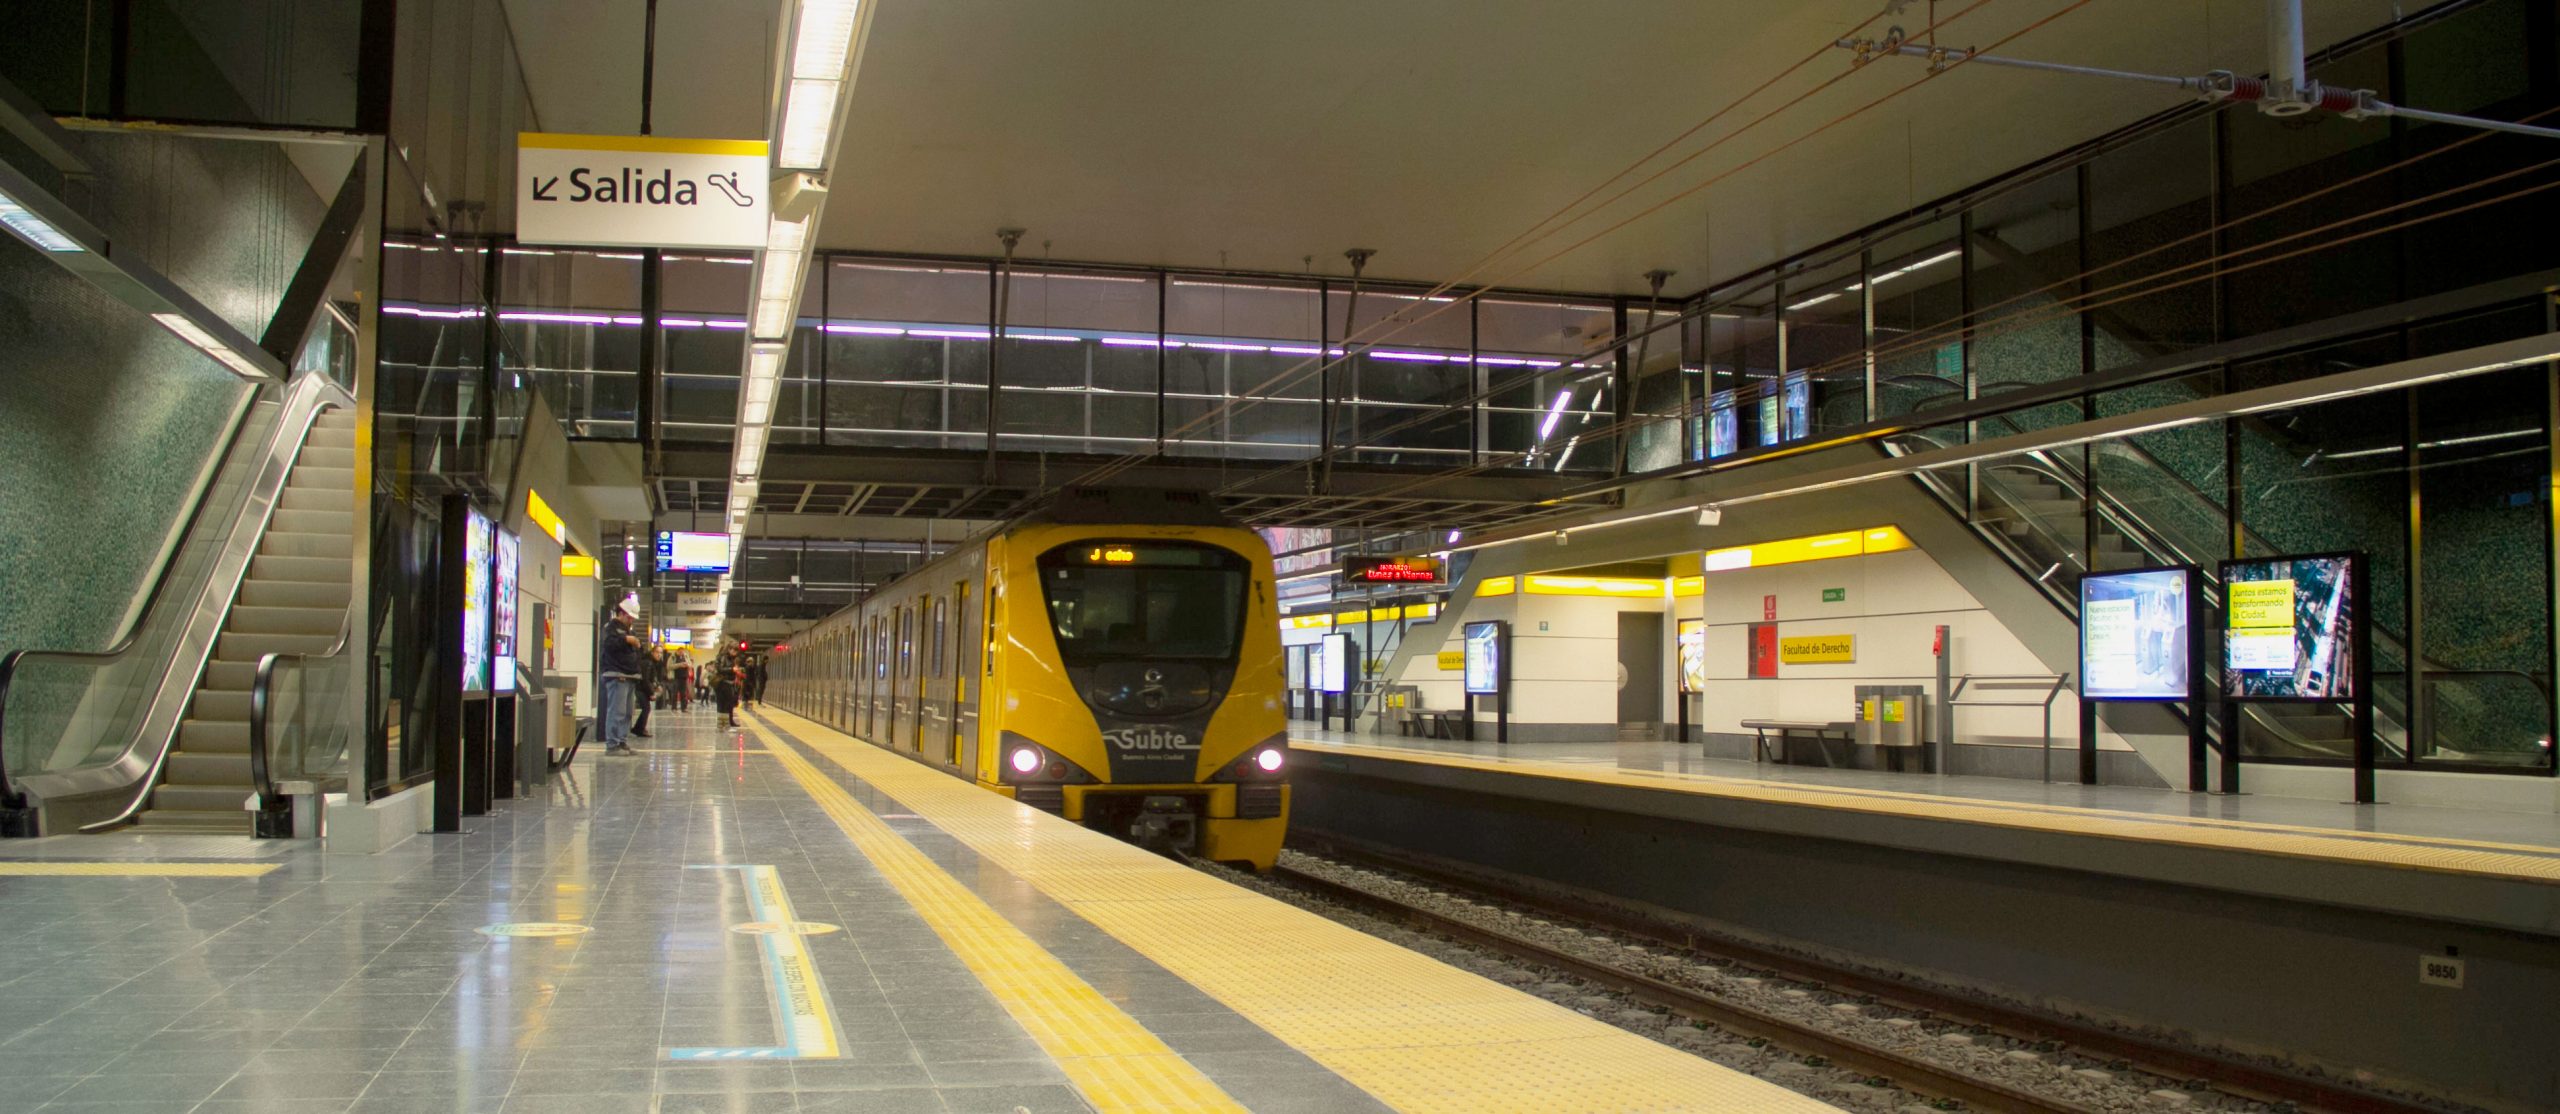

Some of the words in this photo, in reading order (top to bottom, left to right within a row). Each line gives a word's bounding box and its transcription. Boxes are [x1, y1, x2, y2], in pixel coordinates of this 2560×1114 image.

[569, 167, 697, 206] Salida
[1368, 570, 1393, 579] Lunes
[2233, 588, 2256, 598] Juntos
[2257, 587, 2287, 597] estamos
[689, 596, 712, 605] Salida
[2233, 599, 2284, 609] transformando
[2233, 611, 2240, 620] la
[1783, 643, 1810, 655] Facultad
[1811, 642, 1820, 654] de
[1821, 641, 1850, 654] Derecho
[1120, 729, 1187, 750] Subte
[2427, 963, 2457, 980] 9850
